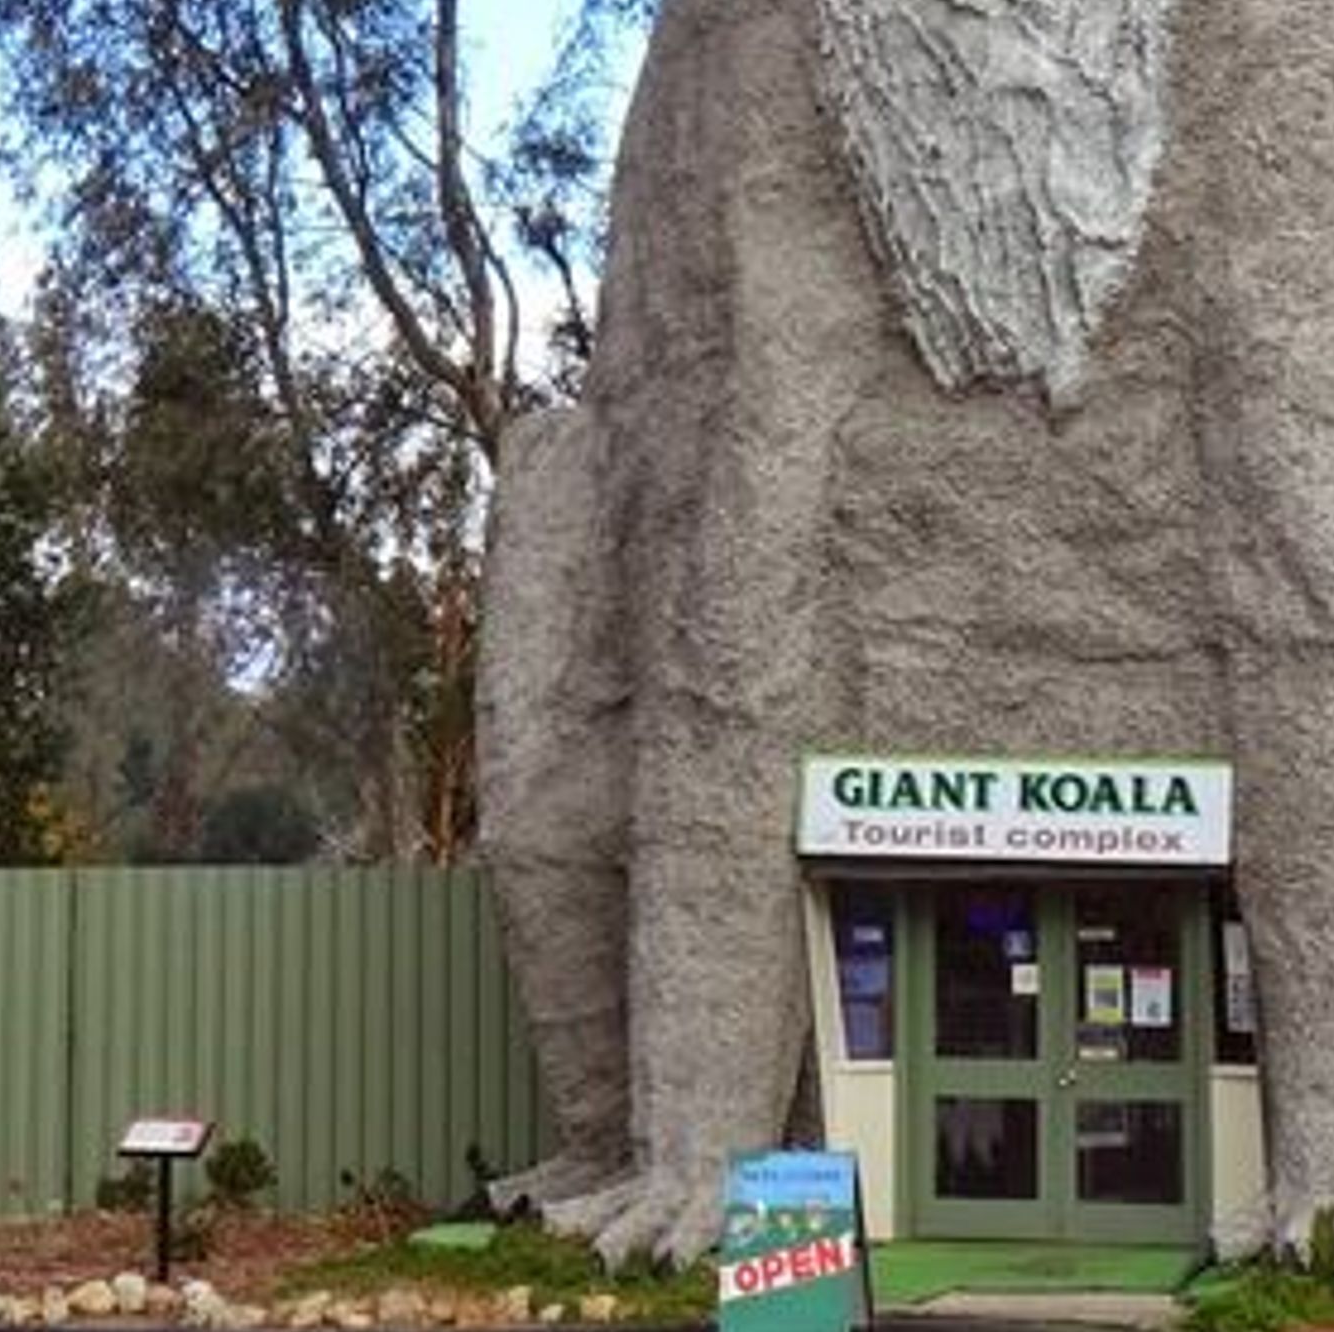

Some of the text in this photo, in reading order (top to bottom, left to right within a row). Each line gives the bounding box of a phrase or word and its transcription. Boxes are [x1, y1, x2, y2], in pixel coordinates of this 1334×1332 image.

[833, 769, 1198, 815] GIANT KOALA
[842, 820, 1183, 854] Tourist complex
[734, 1239, 842, 1291] OPEN
